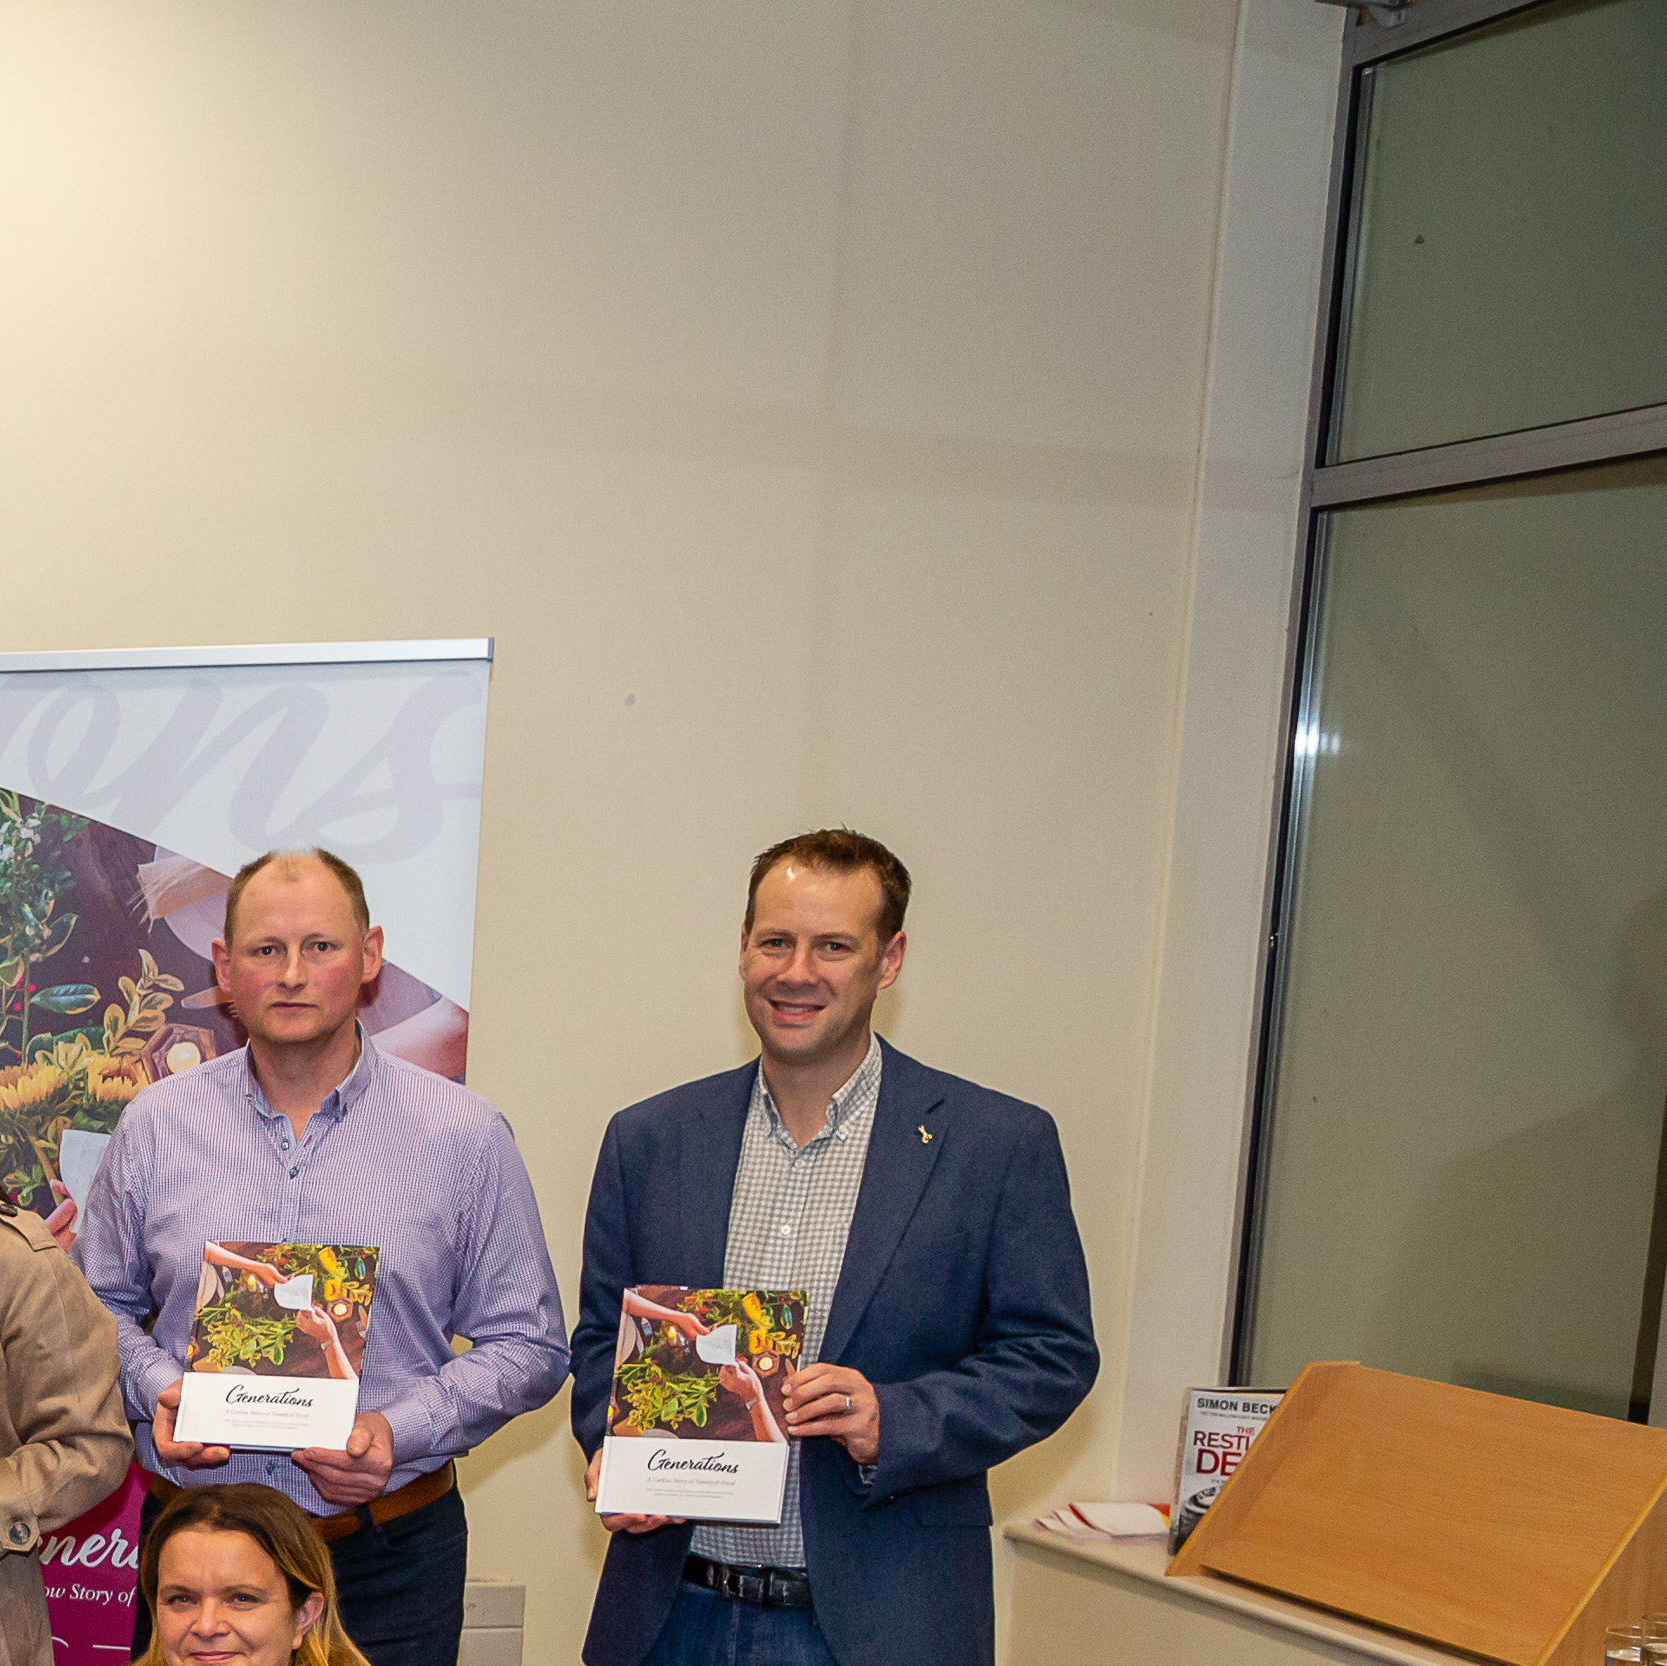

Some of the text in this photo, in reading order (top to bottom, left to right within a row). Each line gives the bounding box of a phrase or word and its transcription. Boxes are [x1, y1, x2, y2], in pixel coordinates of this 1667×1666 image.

[226, 1384, 314, 1407] Generations
[1197, 1398, 1238, 1411] SIMON
[1236, 1426, 1255, 1435] THE
[648, 1449, 739, 1473] Generations
[69, 1583, 113, 1605] Story
[118, 1586, 137, 1607] of
